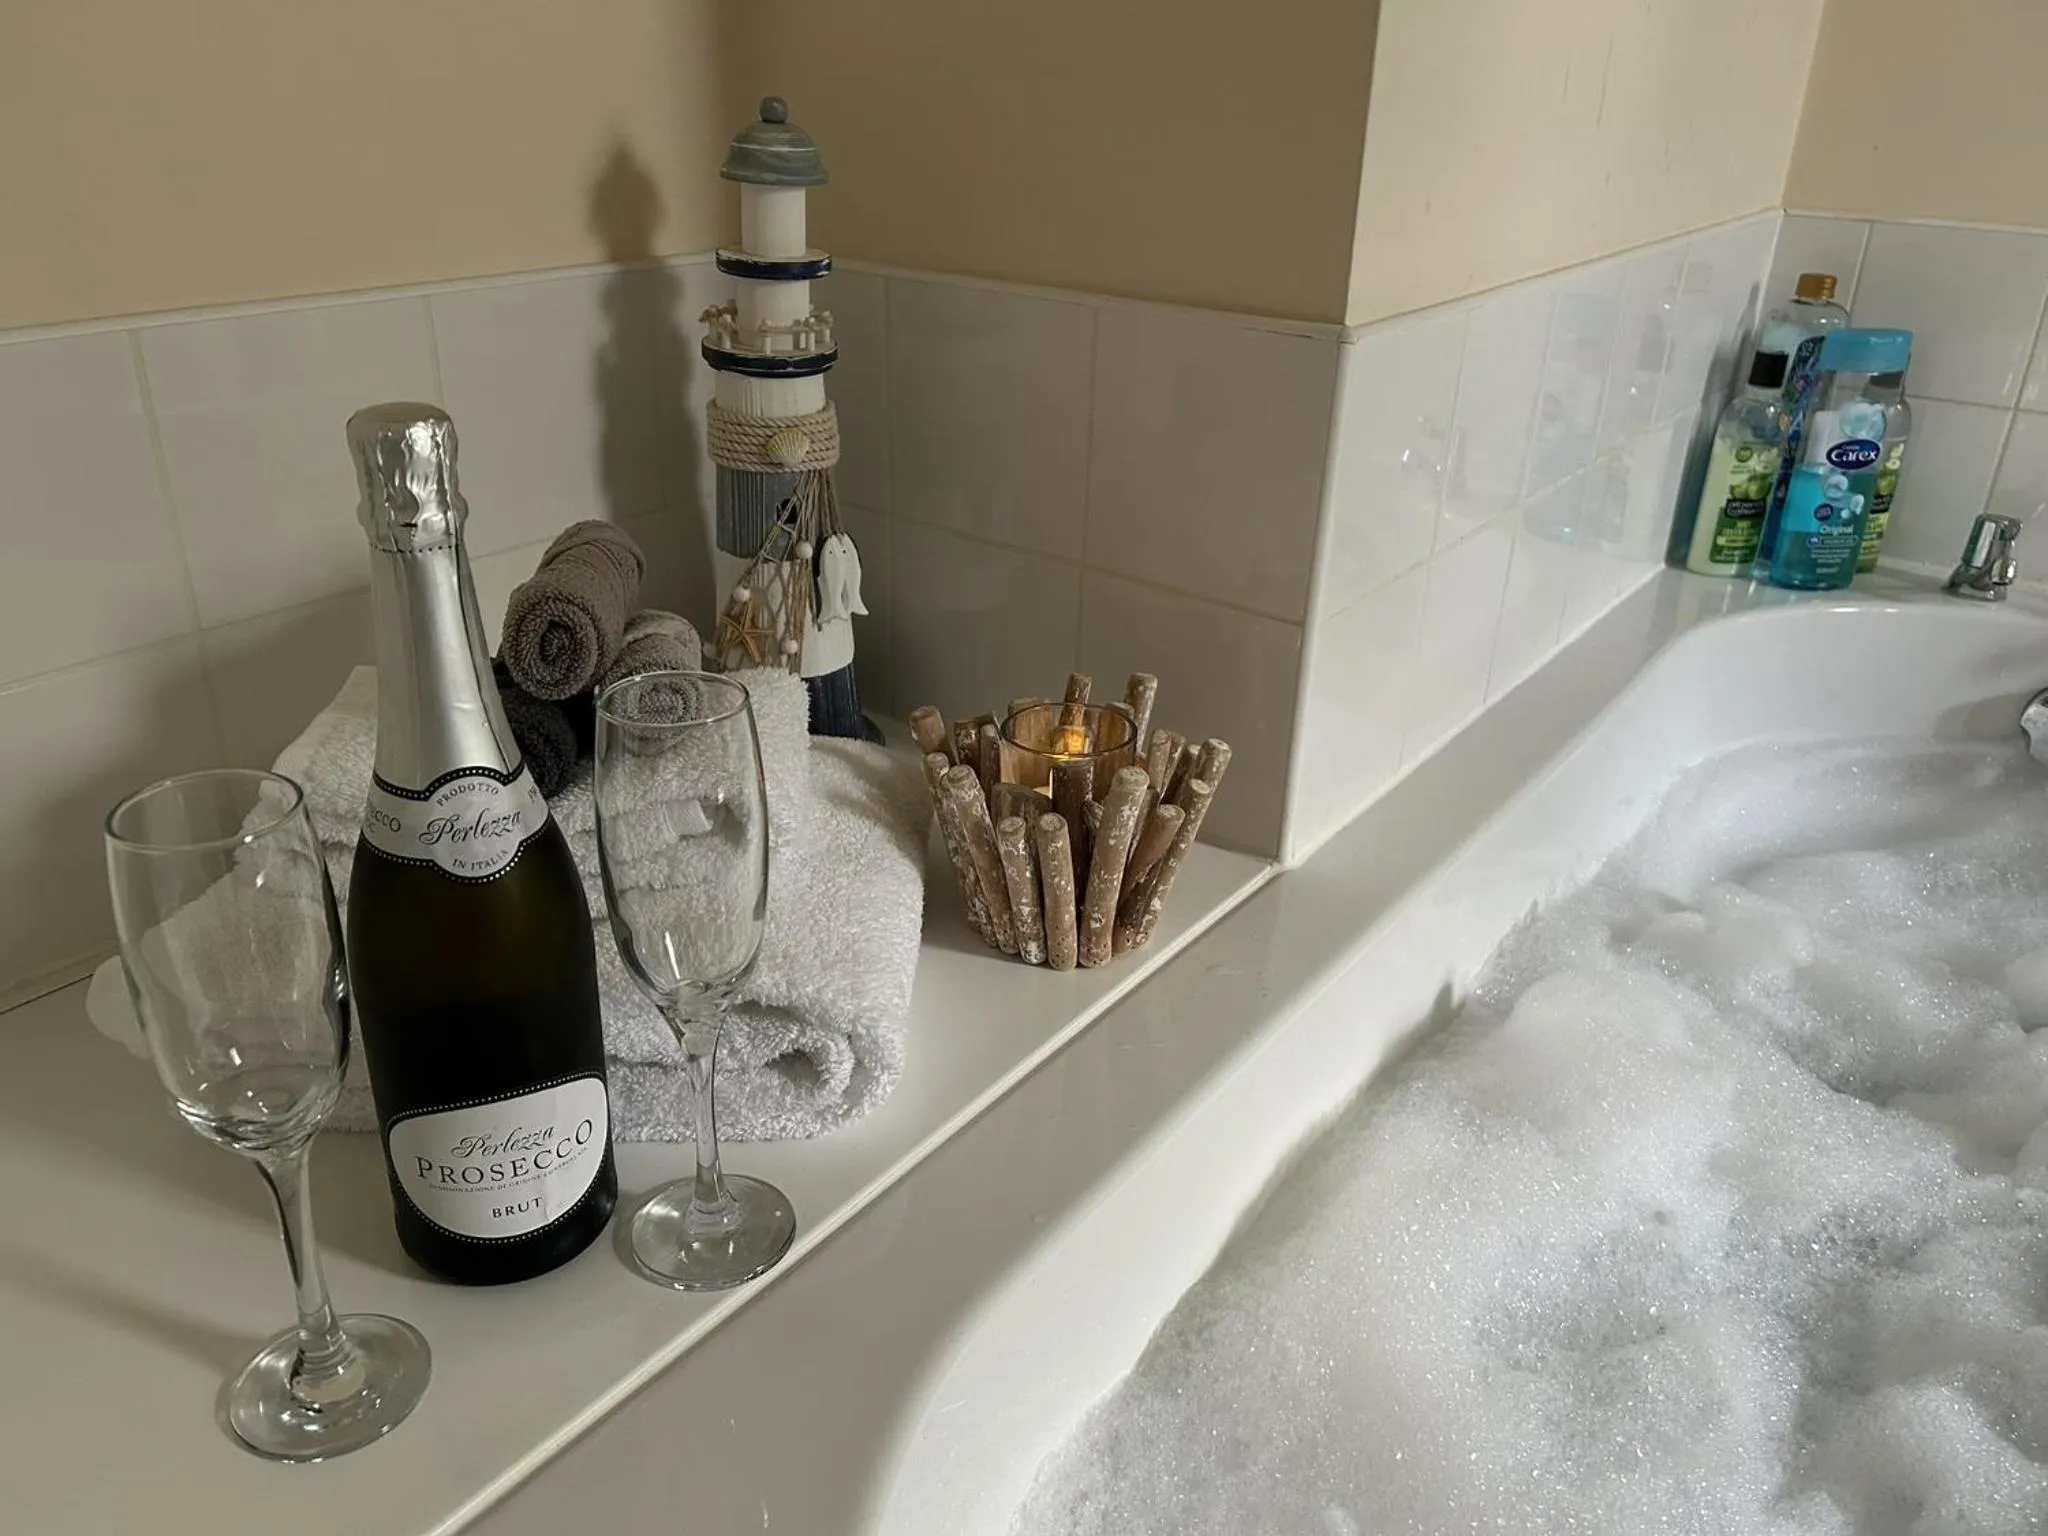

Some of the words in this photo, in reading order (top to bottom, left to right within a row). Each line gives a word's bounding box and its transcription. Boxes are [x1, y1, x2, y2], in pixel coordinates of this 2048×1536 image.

[1830, 449, 1877, 462] Carex
[436, 782, 499, 807] PRODOTTO
[418, 807, 521, 846] Perlezza
[452, 858, 466, 869] IN
[471, 849, 509, 870] ITALIA
[415, 1119, 592, 1185] PROSECCO
[451, 1125, 554, 1158] Perlezza
[492, 1197, 542, 1219] BRUT
